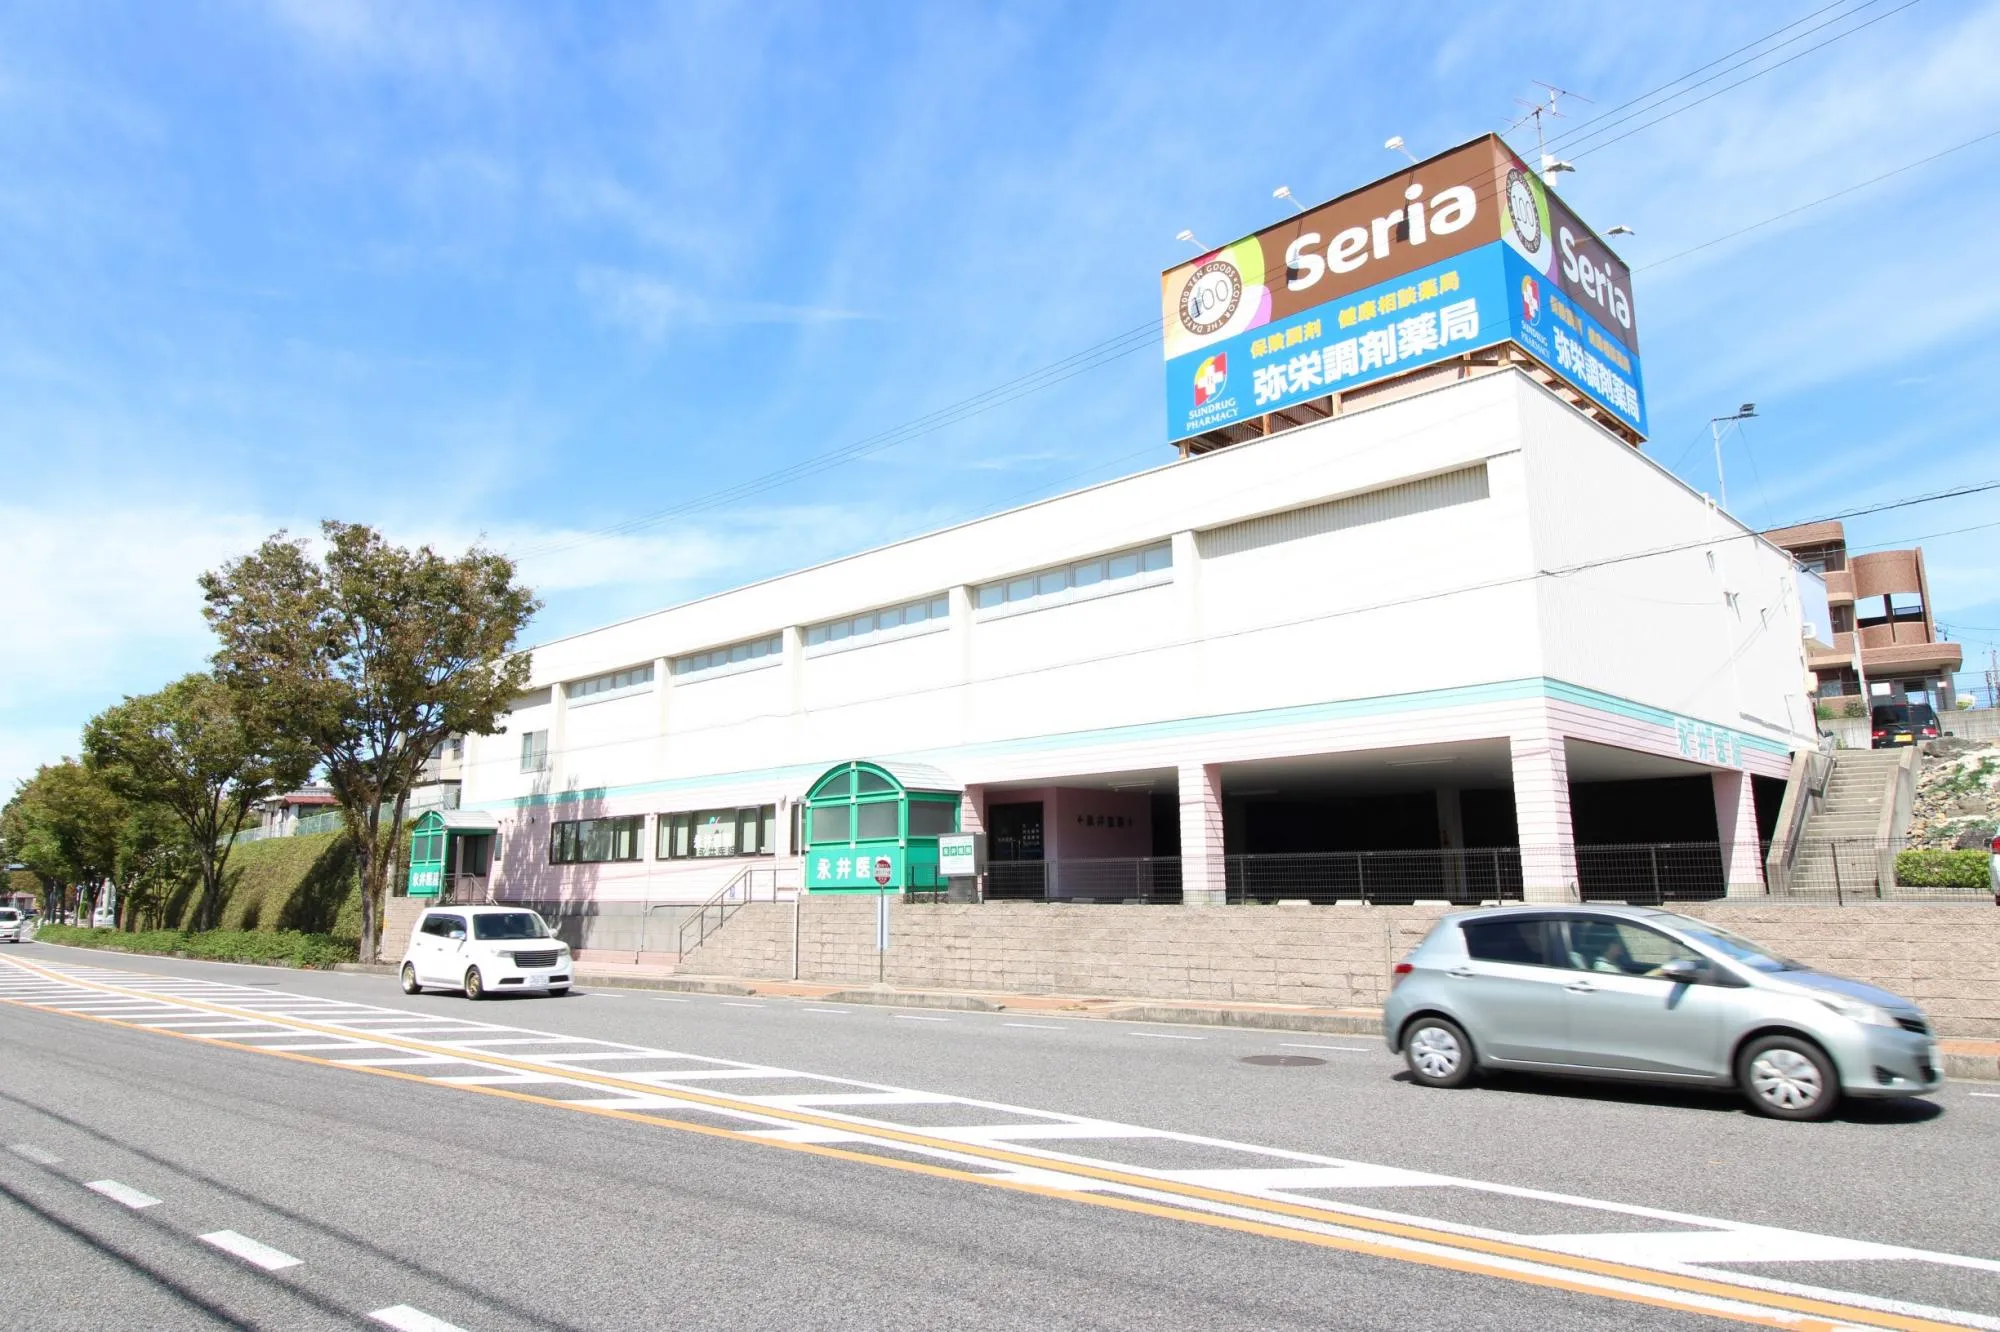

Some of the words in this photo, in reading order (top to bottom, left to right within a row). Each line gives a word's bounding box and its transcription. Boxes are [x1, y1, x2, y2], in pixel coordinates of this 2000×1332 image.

[1206, 263, 1236, 278] GOODS
[1285, 183, 1477, 291] Seria
[1560, 226, 1631, 329] Seria
[1250, 319, 1322, 359] 保険調剤
[1338, 270, 1460, 329] 健康相談薬局
[1252, 298, 1480, 406] 弥栄調剤薬局
[1186, 408, 1239, 431] PHARMACY
[1189, 397, 1237, 419] SUNDRUG
